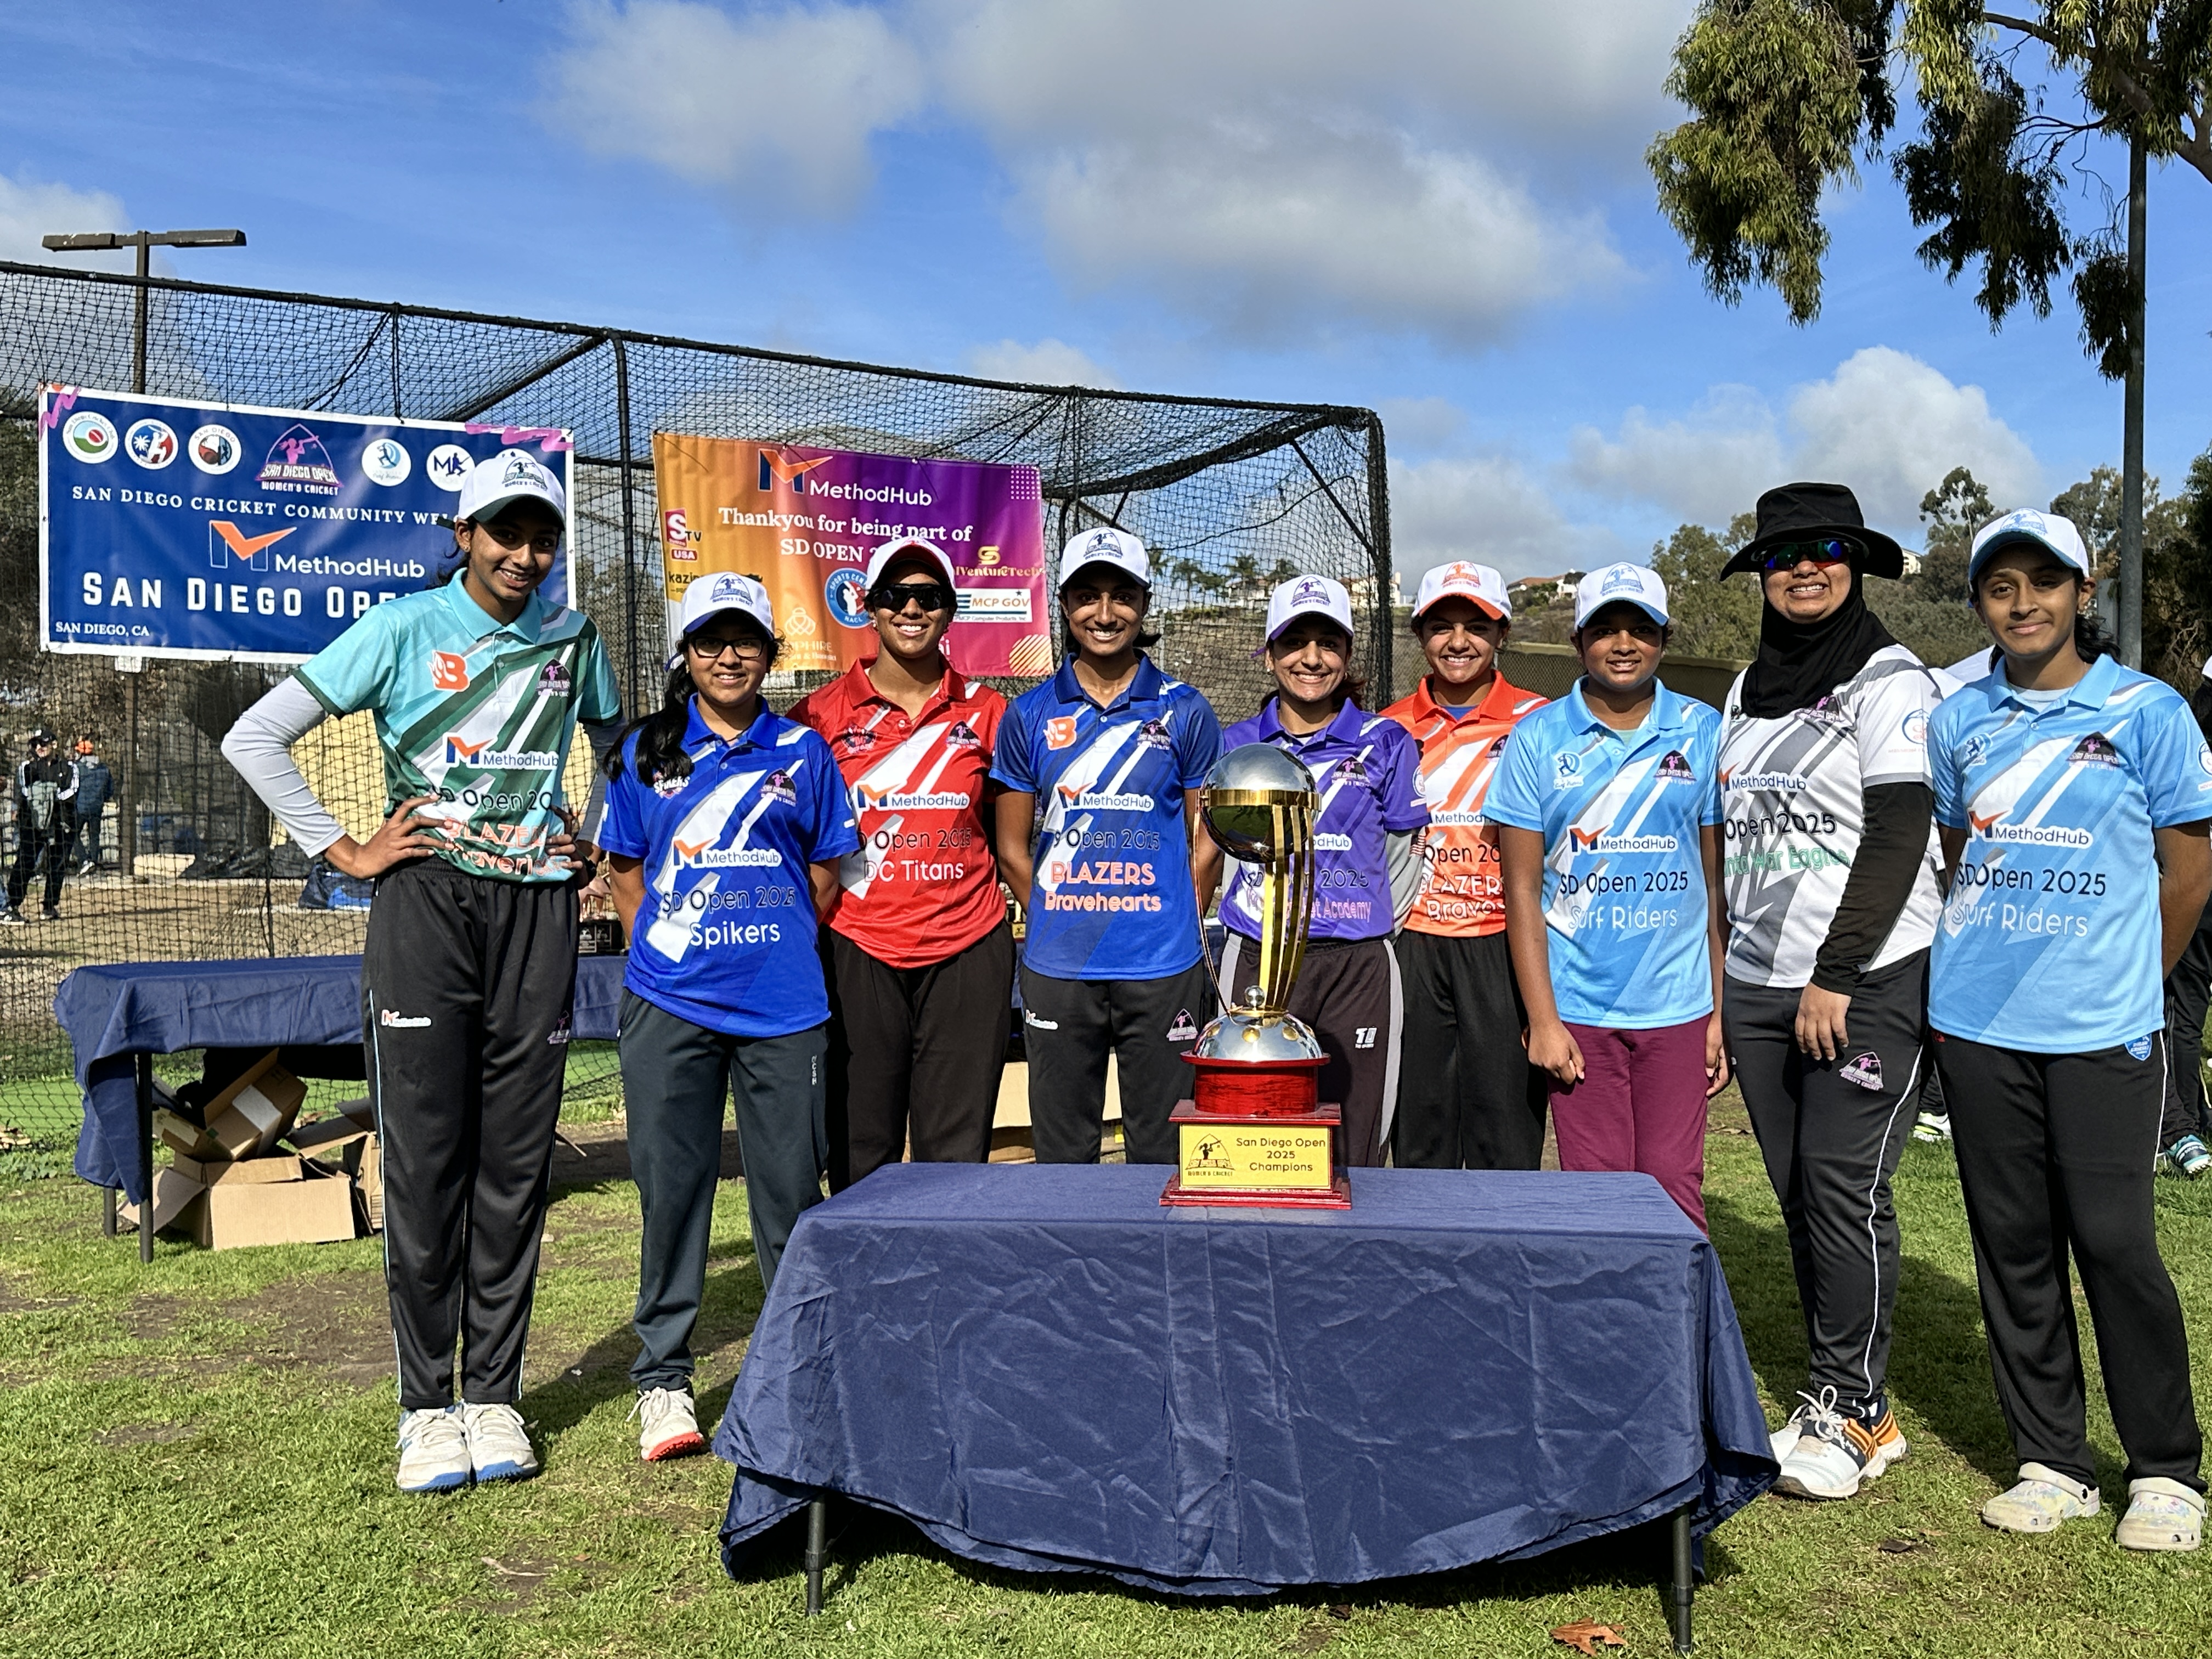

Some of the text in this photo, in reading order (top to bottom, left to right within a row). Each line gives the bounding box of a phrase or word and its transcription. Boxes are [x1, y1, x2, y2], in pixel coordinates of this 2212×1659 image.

[261, 464, 340, 484] SAN DIEGO OPEN
[262, 481, 339, 495] WOMEN'S CRICKET
[810, 479, 932, 506] MethodHub
[72, 486, 112, 501] SAN
[120, 489, 183, 508] DIEGO
[191, 497, 277, 516] CRICKET
[284, 504, 406, 523] COMMUNITY
[718, 507, 974, 542] Thankyou for being part of
[674, 550, 696, 559] USA
[780, 538, 865, 563] SD OPEN
[275, 553, 426, 579] MethodHub
[830, 572, 850, 589] SPORTS
[83, 571, 409, 619] SAN DIEGO OPE
[972, 597, 1030, 607] MCP GOV
[55, 620, 150, 637] SAN DIEGO, CA
[483, 752, 559, 767] MethodHub
[1731, 775, 1807, 791] MethodHub
[462, 788, 523, 811] Open
[891, 794, 969, 807] MethodHub
[1083, 794, 1152, 809] MethodHub
[1725, 811, 1837, 844] Open 2025
[1994, 825, 2090, 845] MethodHub
[874, 830, 931, 853] Open
[1066, 828, 1116, 851] Open
[1601, 835, 1676, 850] MethodHub
[706, 850, 780, 865] MethodHub
[1424, 844, 1472, 866] Open
[864, 859, 964, 883] DC Titans
[1051, 861, 1156, 885] BLAZERS
[1319, 868, 1370, 888] 2025
[1957, 862, 2107, 896] SD Open 2025
[1560, 870, 1689, 896] SD Open 2025
[662, 891, 683, 915] SD
[689, 887, 751, 914] Open
[1045, 890, 1162, 912] Bravehearts
[1323, 896, 1372, 923] Academy
[1568, 905, 1678, 930] Surf Riders
[1952, 901, 2089, 938] Surf Riders
[690, 922, 781, 950] Spikers
[1236, 1137, 1326, 1149] San Diego Open
[1267, 1150, 1296, 1159] 2025
[1249, 1161, 1313, 1173] Champions
